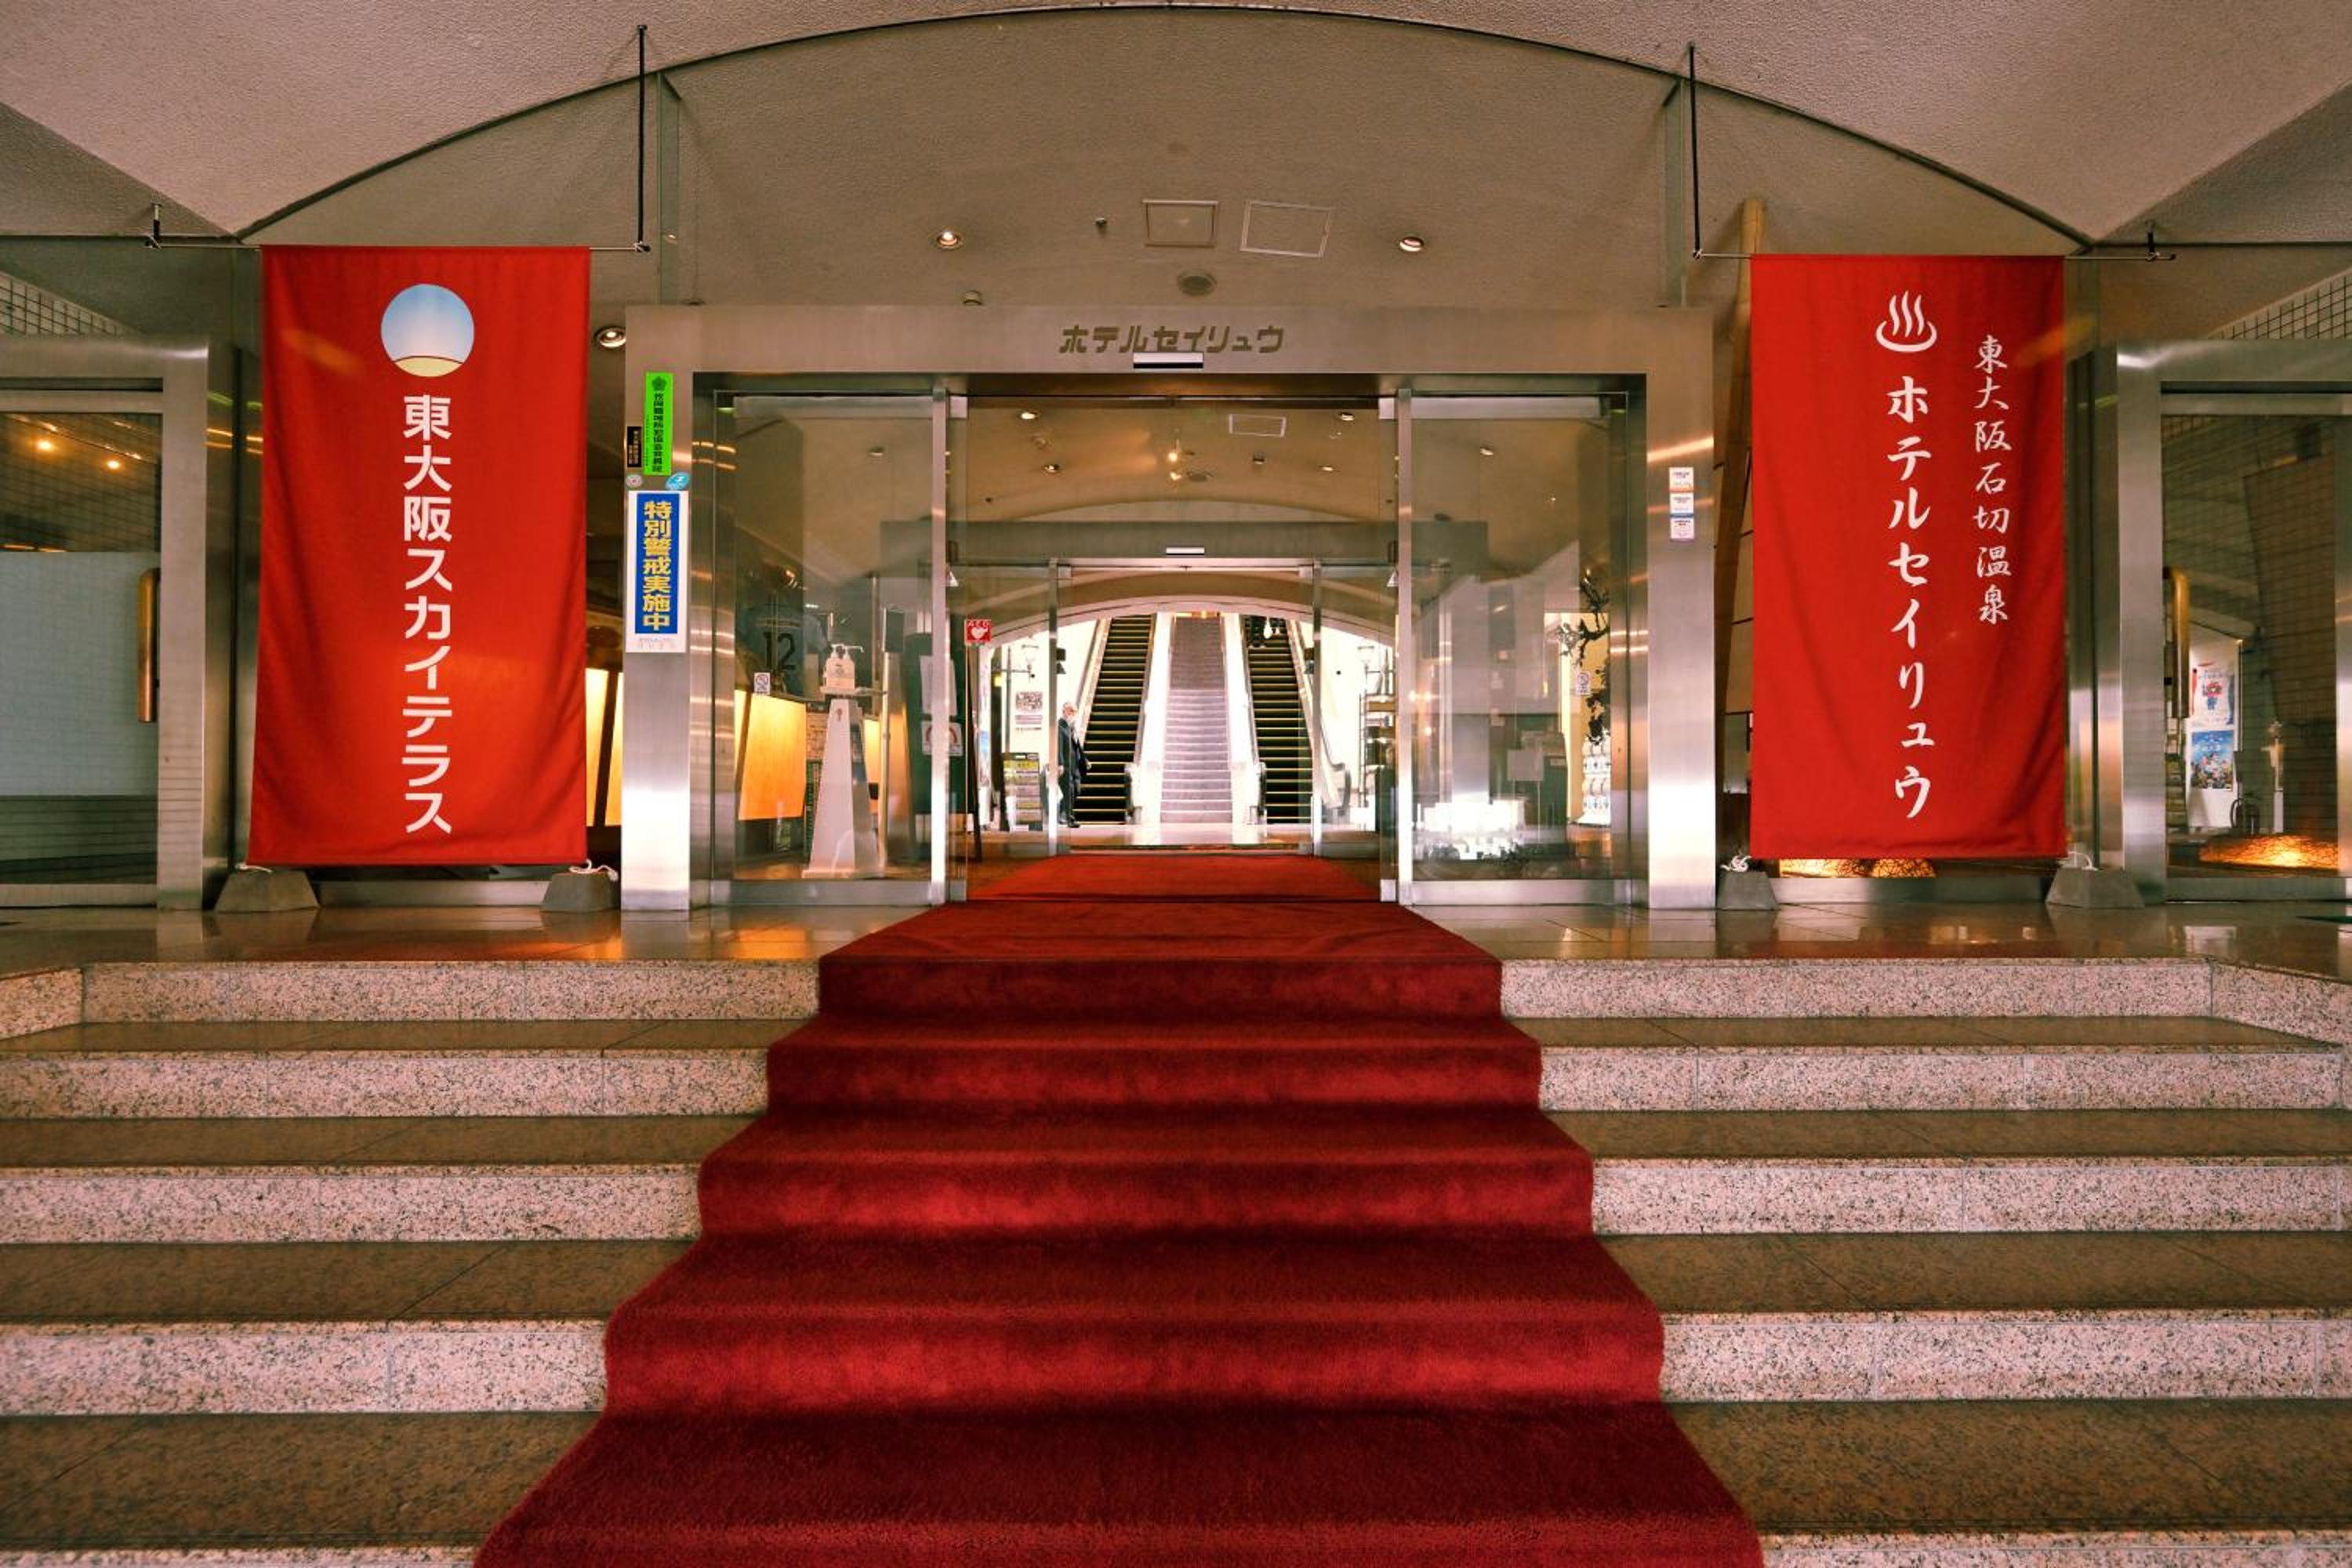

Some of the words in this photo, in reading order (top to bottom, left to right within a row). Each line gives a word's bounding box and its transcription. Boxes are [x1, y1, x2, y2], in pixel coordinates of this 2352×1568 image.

[1058, 324, 1284, 354] ホテルセイリュウ
[641, 500, 673, 632] 特別警戒実施中
[1973, 334, 2012, 626] 東大阪石切温泉
[401, 394, 452, 833] 東大阪スカイテラス
[763, 631, 796, 670] 12
[1886, 375, 1935, 818] ホテルセイリュウ
